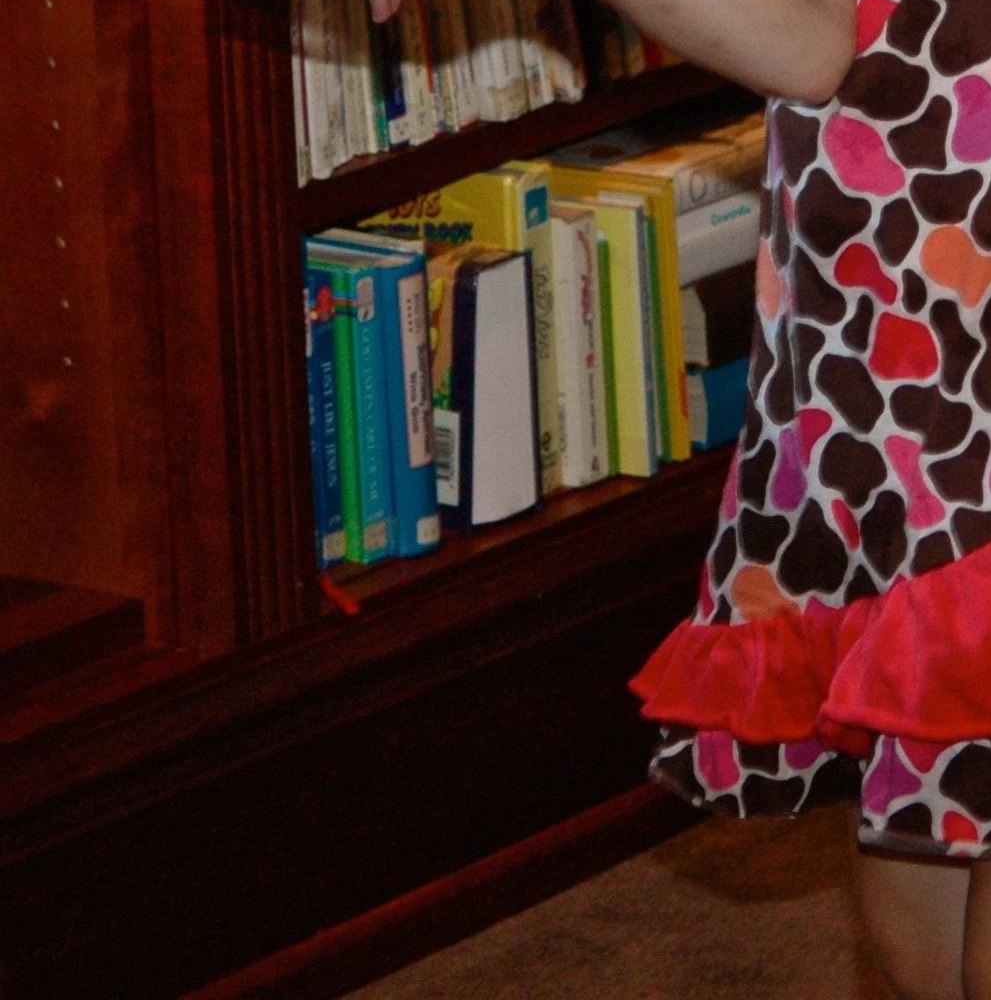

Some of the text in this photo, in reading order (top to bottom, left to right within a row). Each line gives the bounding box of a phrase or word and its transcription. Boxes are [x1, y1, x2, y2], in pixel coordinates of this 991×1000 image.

[318, 360, 340, 487] JUST LIKE JESUS
